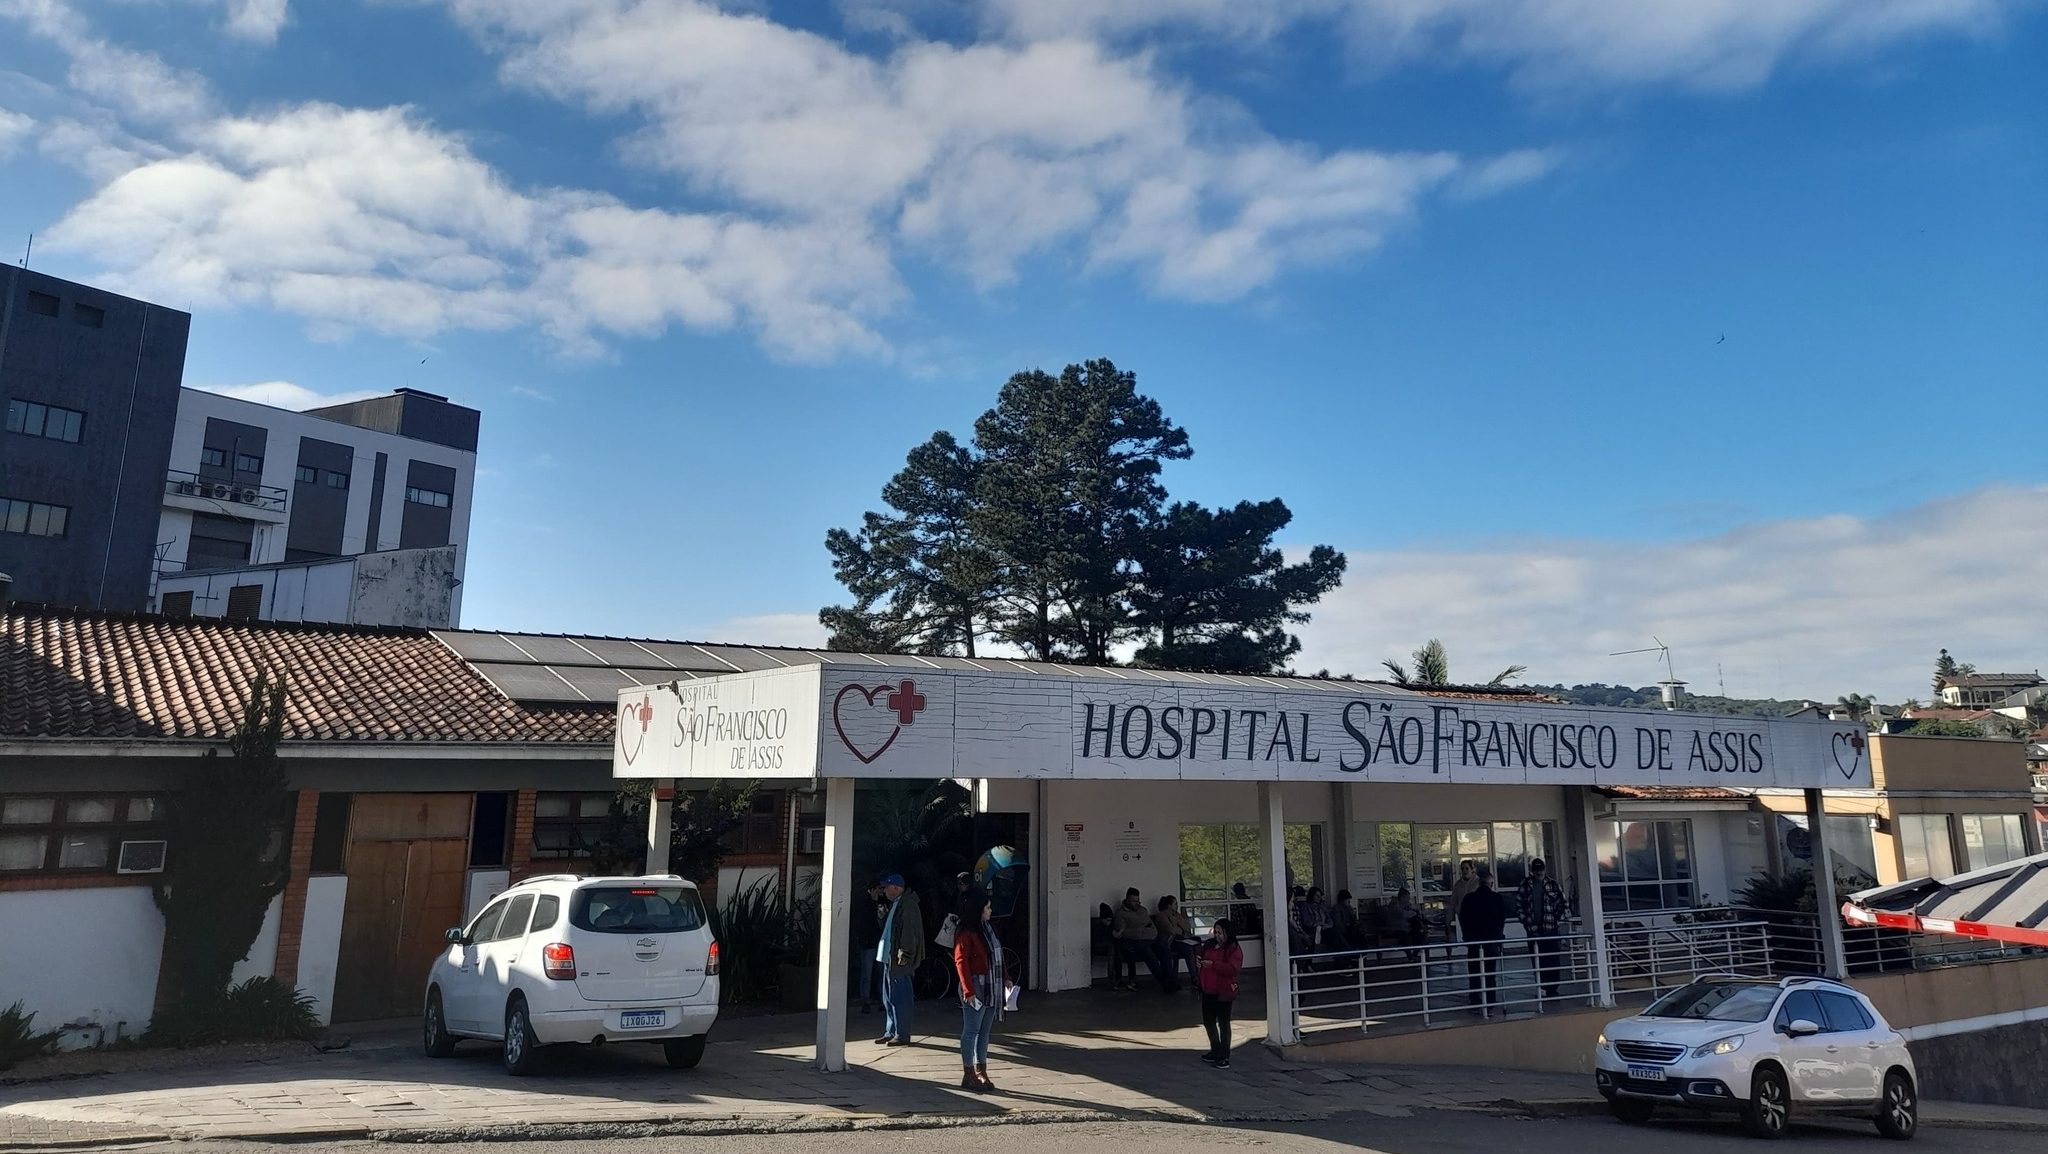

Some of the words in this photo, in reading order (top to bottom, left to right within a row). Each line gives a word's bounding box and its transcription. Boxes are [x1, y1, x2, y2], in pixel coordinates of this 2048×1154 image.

[730, 746, 746, 770] DE
[748, 745, 784, 770] ASSIS
[1083, 702, 1321, 763] HOSPITAL
[1634, 727, 1673, 771] DE
[1687, 729, 1764, 774] ASSIS
